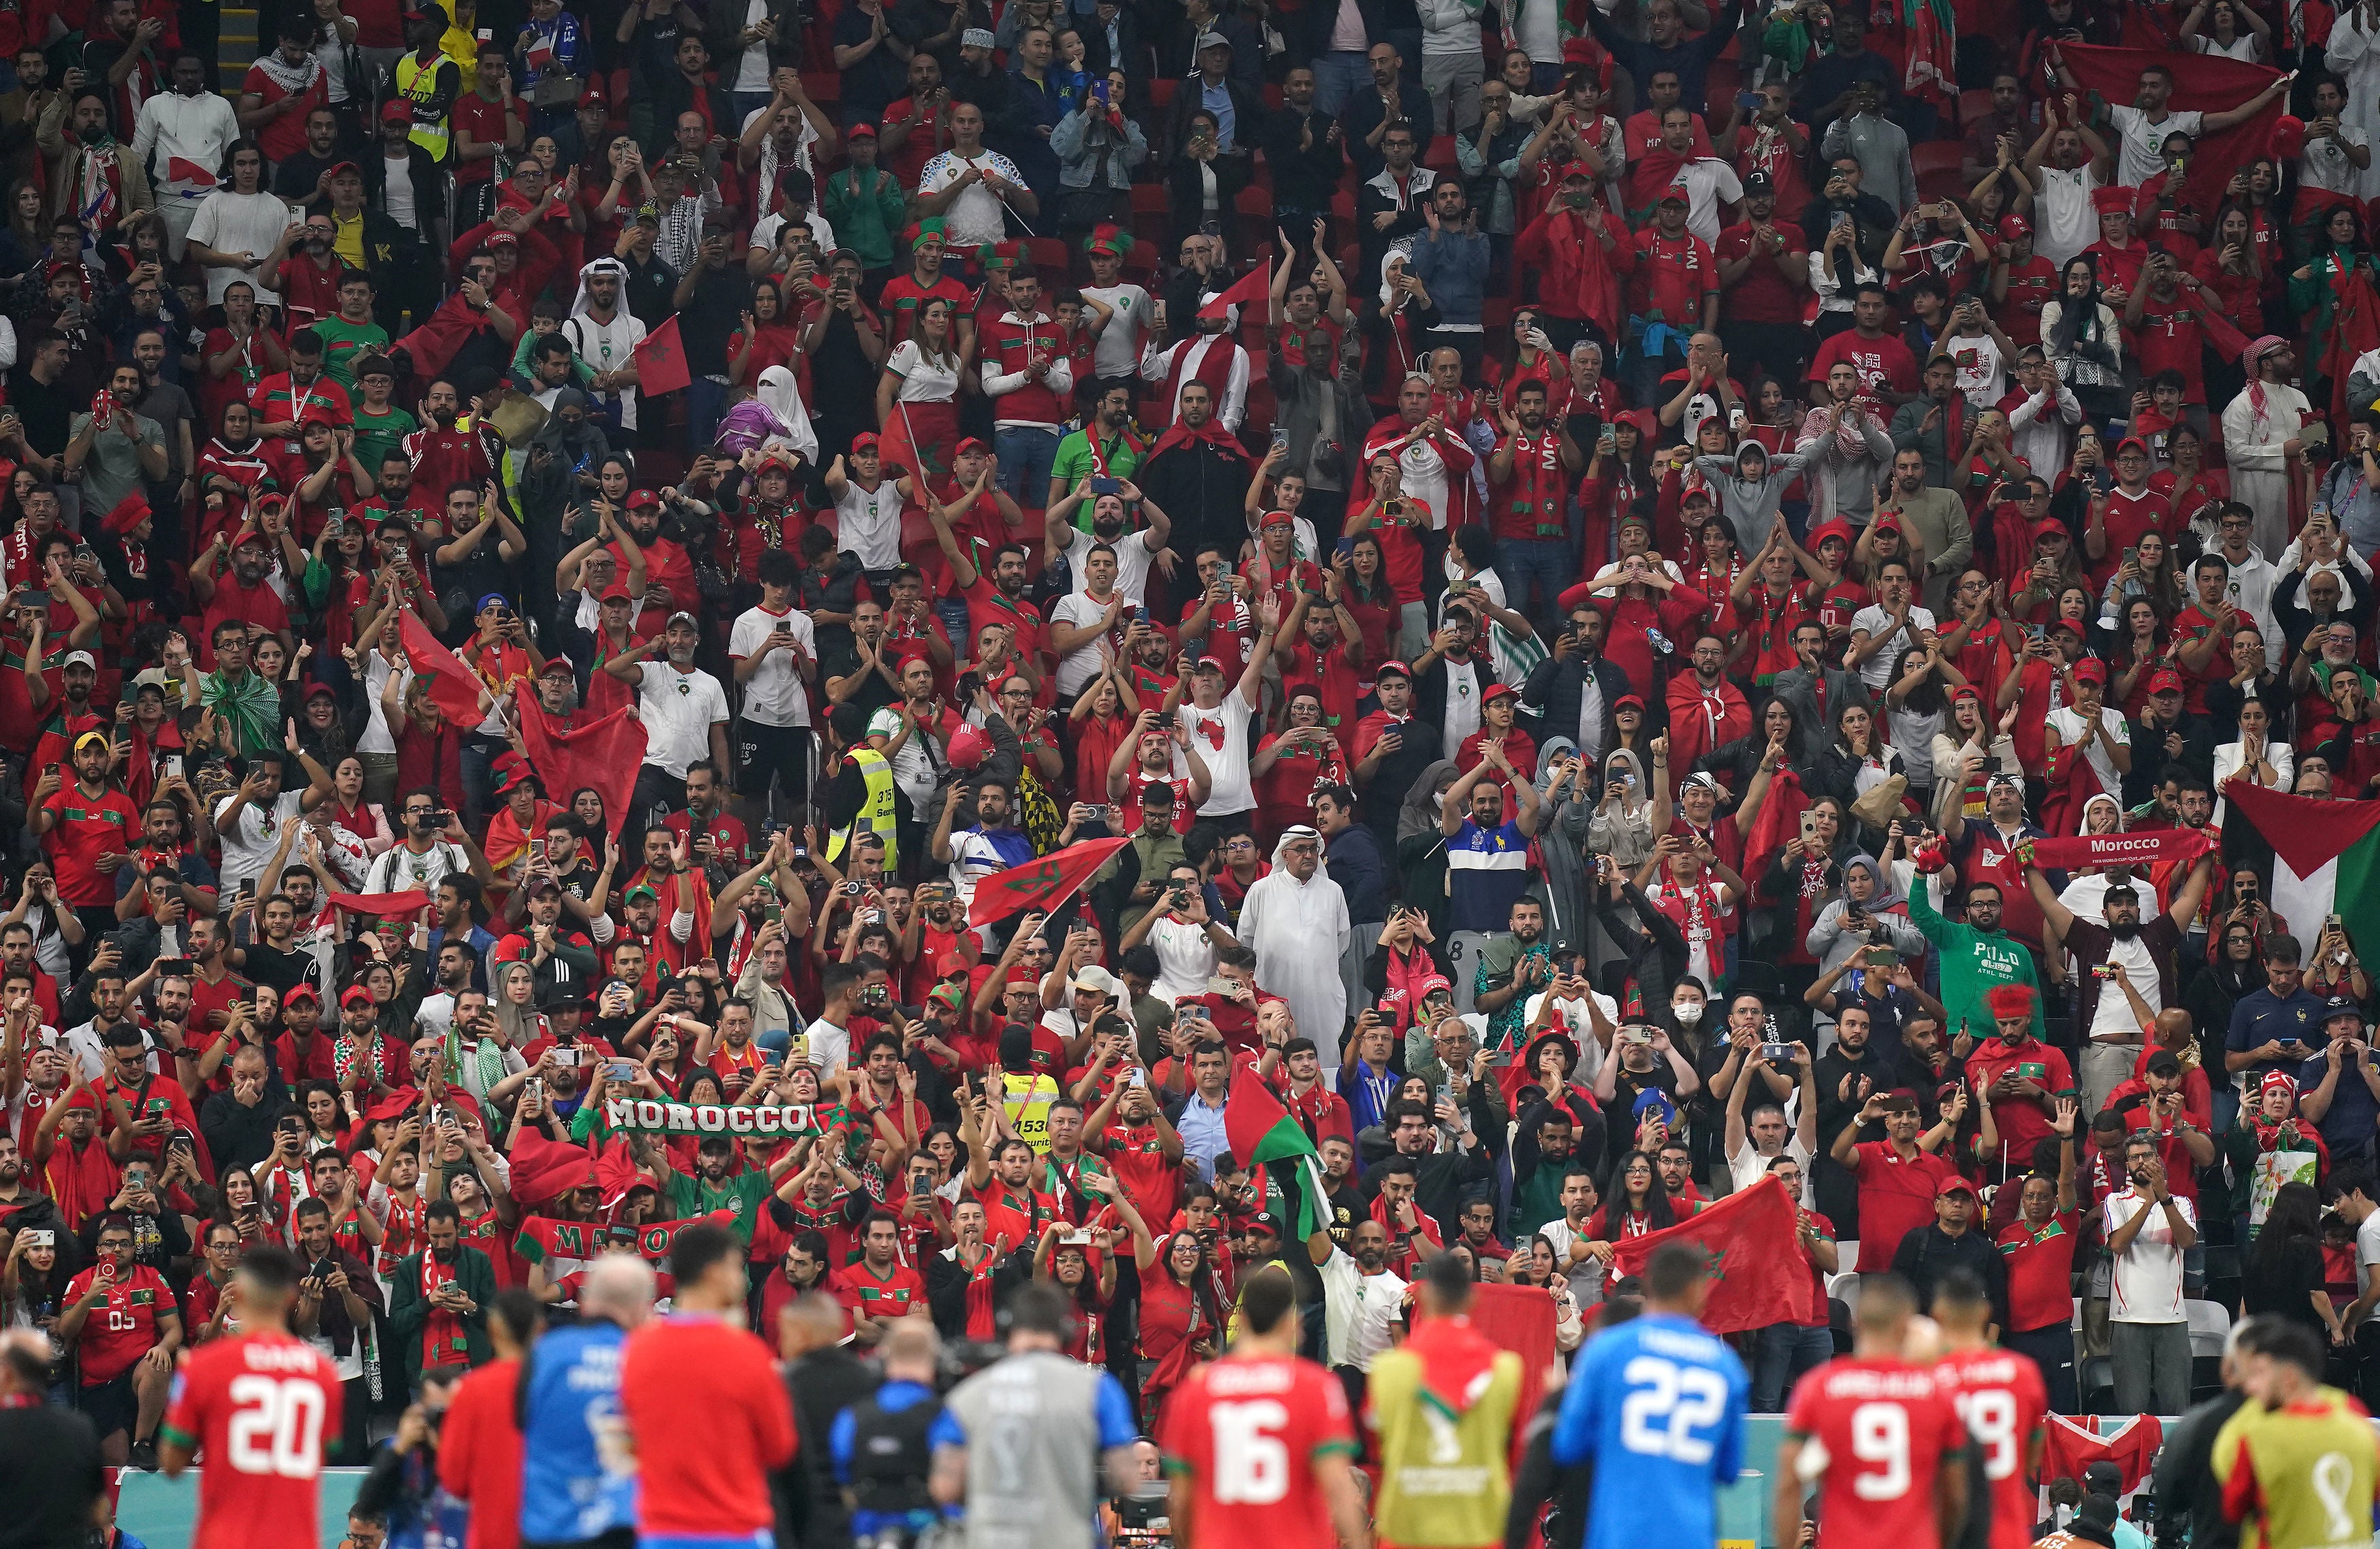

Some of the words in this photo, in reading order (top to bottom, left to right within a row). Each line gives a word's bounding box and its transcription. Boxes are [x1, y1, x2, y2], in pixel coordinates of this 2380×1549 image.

[1714, 602, 1724, 622] 7
[1820, 609, 1836, 626] 10
[877, 806, 896, 818] Securit
[2091, 838, 2160, 853] Morocco
[1449, 940, 1463, 961] 8
[1998, 972, 2014, 981] DEPT
[607, 1097, 809, 1133] MOROCCO
[109, 1310, 136, 1331] 05
[1620, 1355, 1729, 1467] 22
[228, 1373, 326, 1479] 20
[1208, 1398, 1291, 1506] 16
[1850, 1401, 1911, 1502] 9
